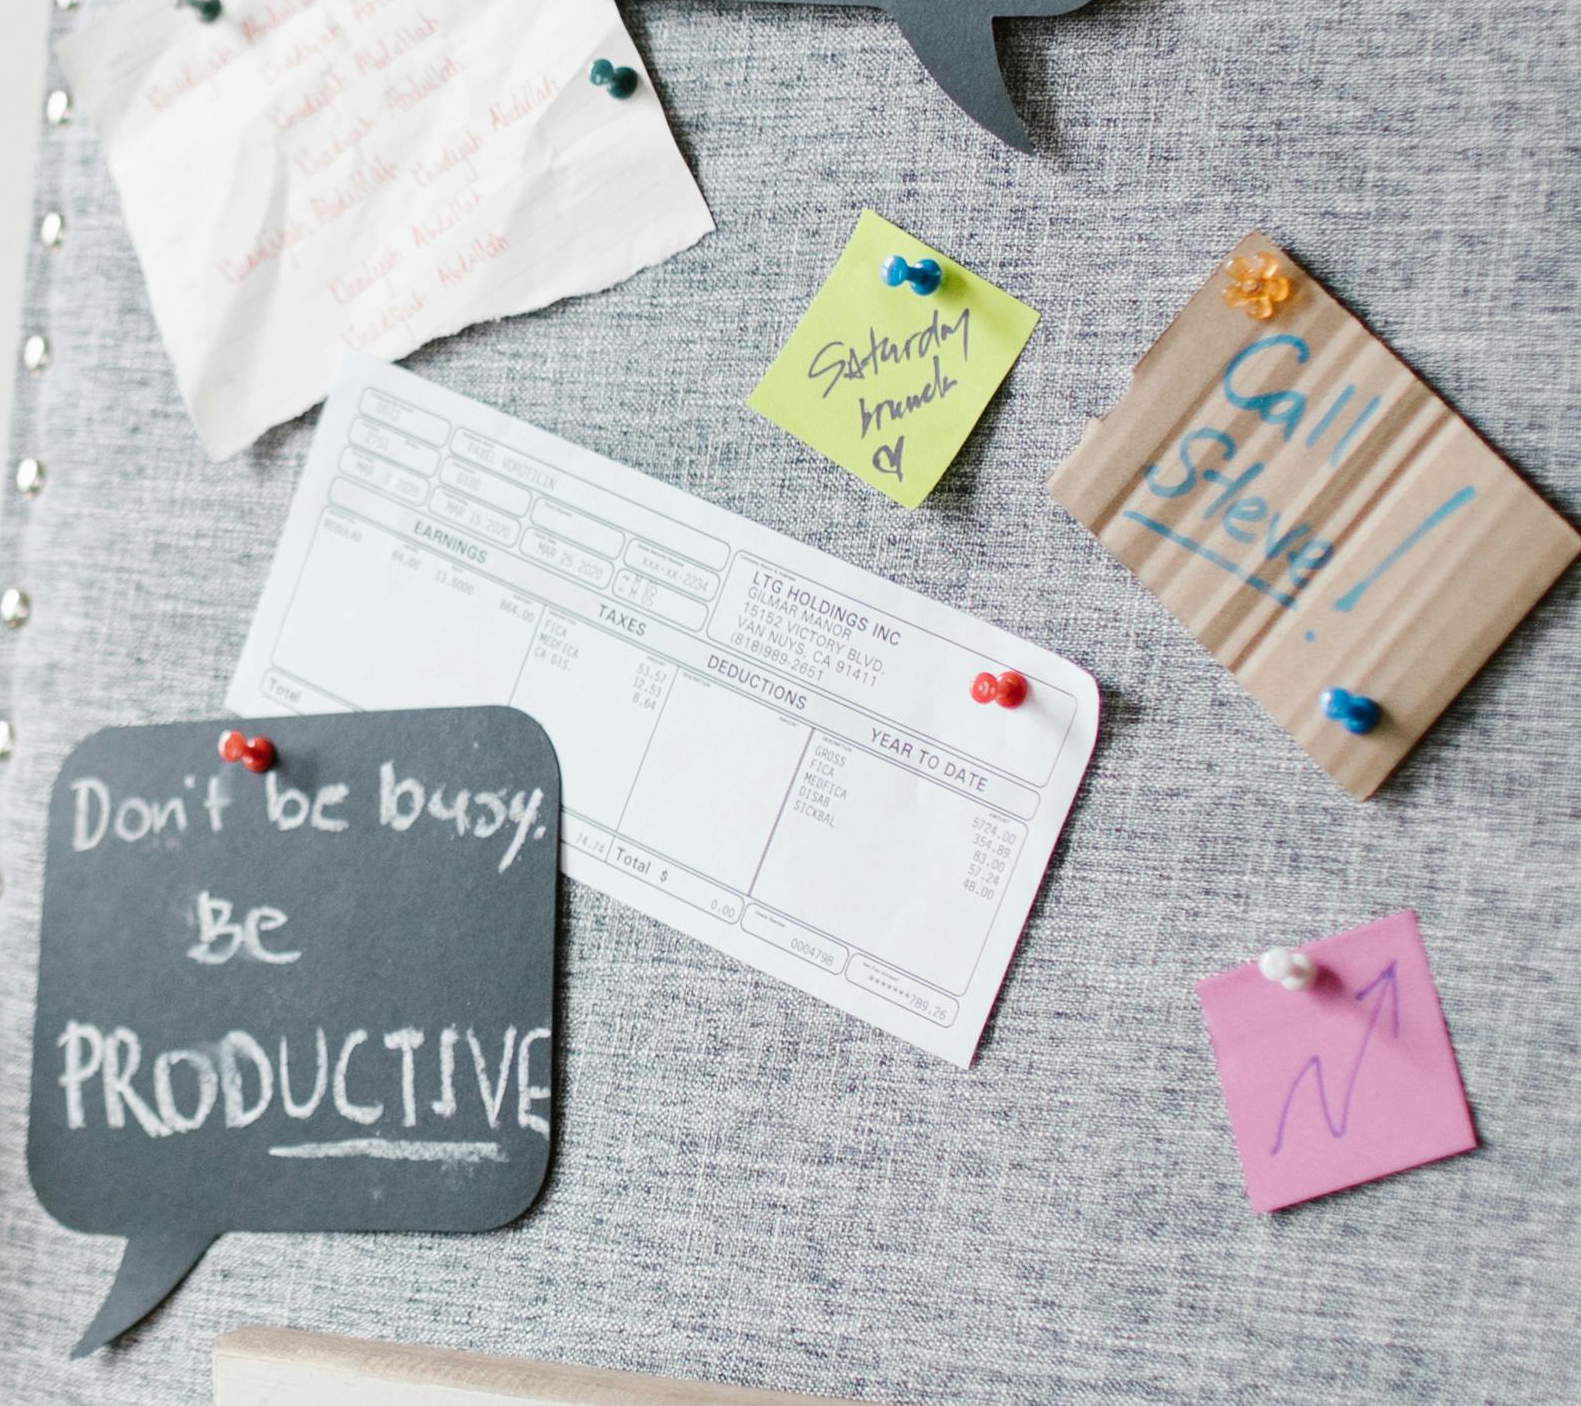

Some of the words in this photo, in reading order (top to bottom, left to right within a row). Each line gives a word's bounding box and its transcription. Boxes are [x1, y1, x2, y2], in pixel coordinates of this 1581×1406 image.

[859, 355, 958, 439] brunch
[1224, 333, 1380, 468] Call
[411, 520, 489, 566] EARNINGS
[595, 603, 648, 638] TAXES
[741, 601, 783, 630] 15152
[784, 620, 846, 657] VICTORY
[746, 585, 799, 618] GILMAR
[799, 608, 853, 642] MANOR
[751, 569, 784, 596] LTG
[785, 584, 870, 634] HOLDINGS
[871, 622, 903, 648] INC
[532, 645, 547, 661] CA
[630, 691, 657, 712] 8.64
[536, 632, 580, 660] MEDFICA
[631, 676, 663, 699] 12.53
[541, 618, 569, 640] FICA
[635, 662, 667, 685] 53.57
[705, 653, 809, 711] DEDUCTIONS
[729, 630, 824, 682] (818)989-2651
[735, 615, 766, 639] VAN
[766, 629, 810, 660] NUYS,
[811, 649, 833, 669] CA
[834, 659, 878, 689] 91411
[264, 675, 304, 705] Total
[813, 744, 847, 769] GROSS
[971, 816, 1017, 846] 5724.00
[868, 727, 915, 759] YEAR
[915, 748, 941, 771] TO
[942, 761, 989, 793] DATE
[70, 775, 223, 852] Don't
[264, 771, 350, 832] be
[797, 785, 832, 809] DISAB
[966, 862, 1001, 888] 57.24
[802, 771, 848, 801] MEDFICA
[971, 848, 1007, 874] 83.00
[807, 757, 836, 779] FICA
[971, 832, 1011, 860] 354.89
[612, 845, 653, 876] Total
[658, 867, 670, 884] $
[708, 897, 737, 920] 0.00
[792, 799, 838, 829] SICKBAL
[960, 876, 996, 902] 48.00
[788, 936, 836, 967] 0004798
[57, 1019, 551, 1139] PRODUCTIVE
